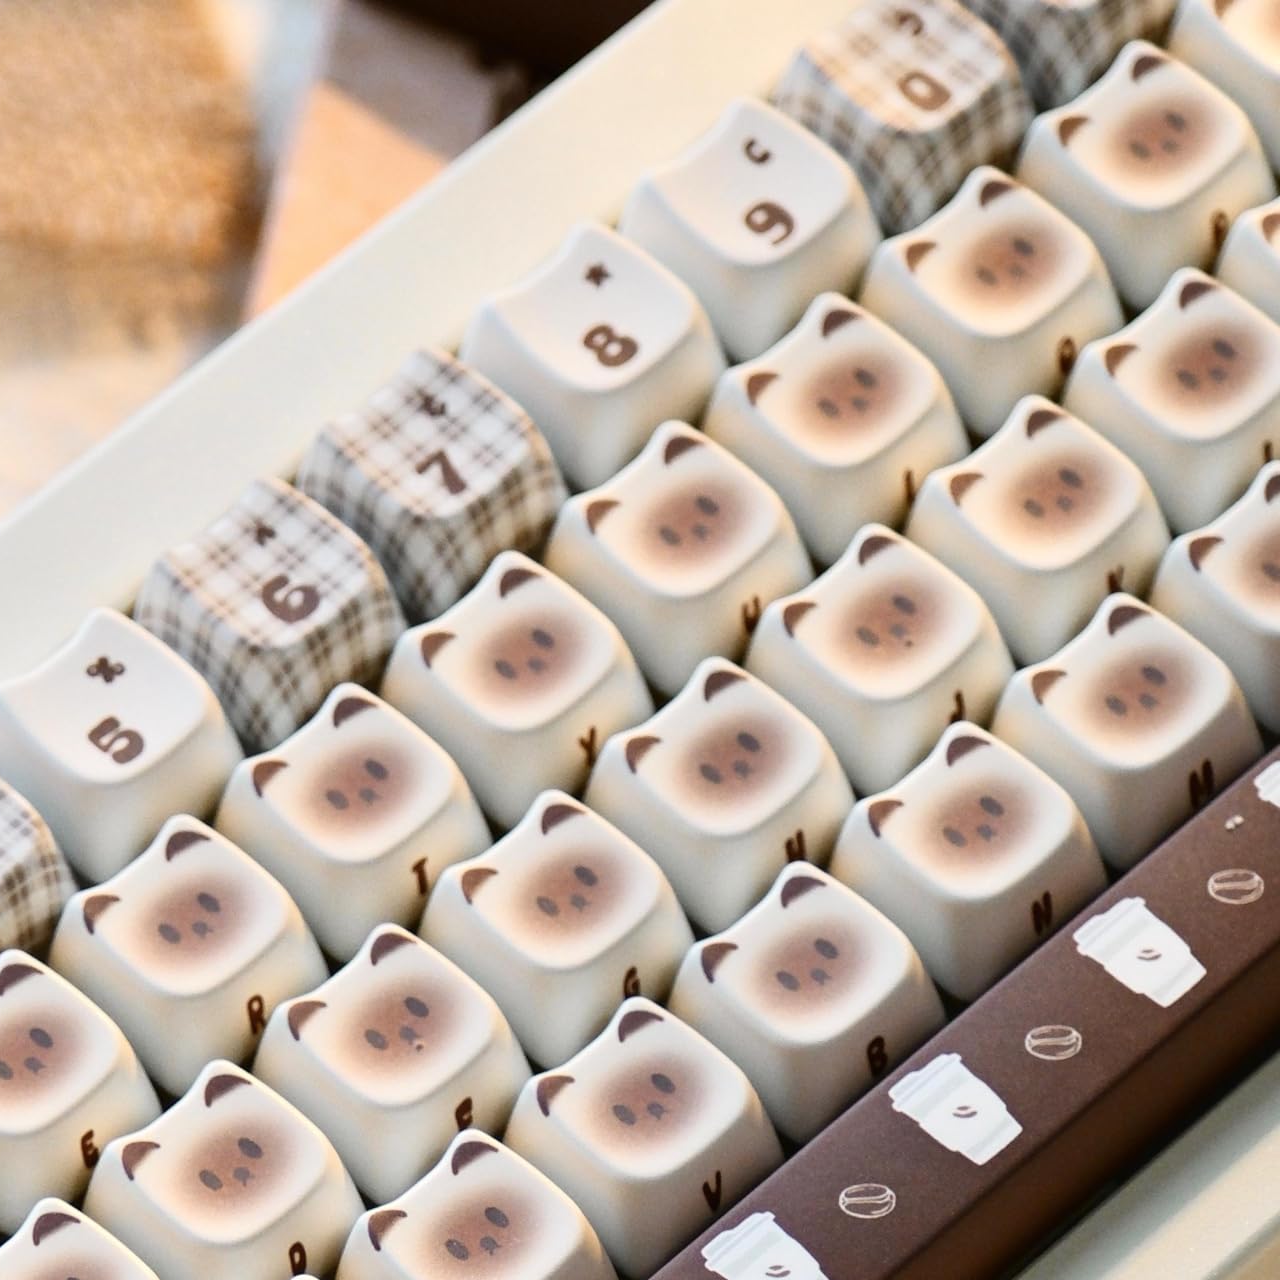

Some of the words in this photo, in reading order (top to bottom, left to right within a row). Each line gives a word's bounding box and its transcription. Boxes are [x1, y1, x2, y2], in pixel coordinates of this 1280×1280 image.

[744, 201, 794, 245] 9
[583, 324, 639, 367] 8
[415, 449, 468, 494] 7
[261, 575, 320, 624] 6
[88, 716, 145, 764] 5
